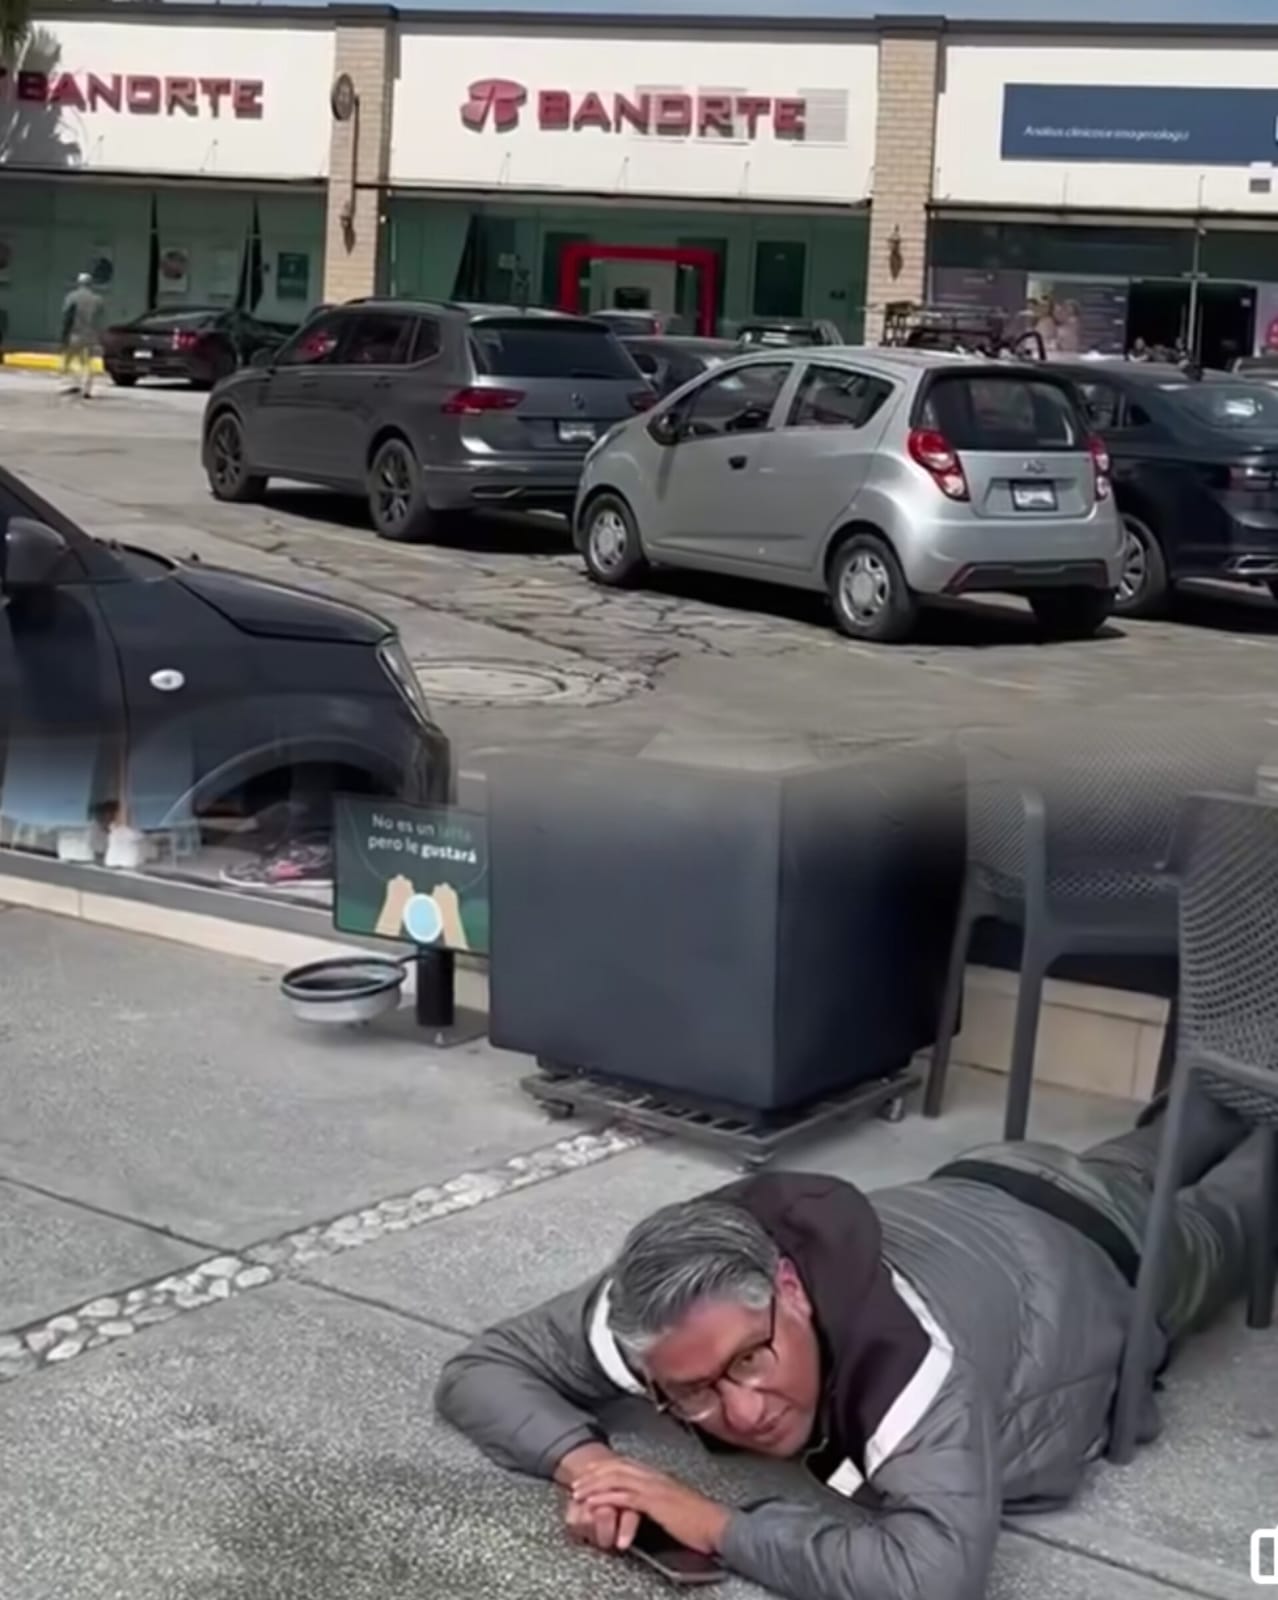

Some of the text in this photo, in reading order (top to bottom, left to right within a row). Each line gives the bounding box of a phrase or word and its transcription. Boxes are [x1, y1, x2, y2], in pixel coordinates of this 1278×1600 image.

[17, 71, 263, 119] BANORTE
[537, 89, 806, 141] BANORTE
[372, 814, 393, 829] No
[397, 821, 413, 833] es
[416, 824, 435, 837] un
[368, 836, 477, 864] pero le gustará
